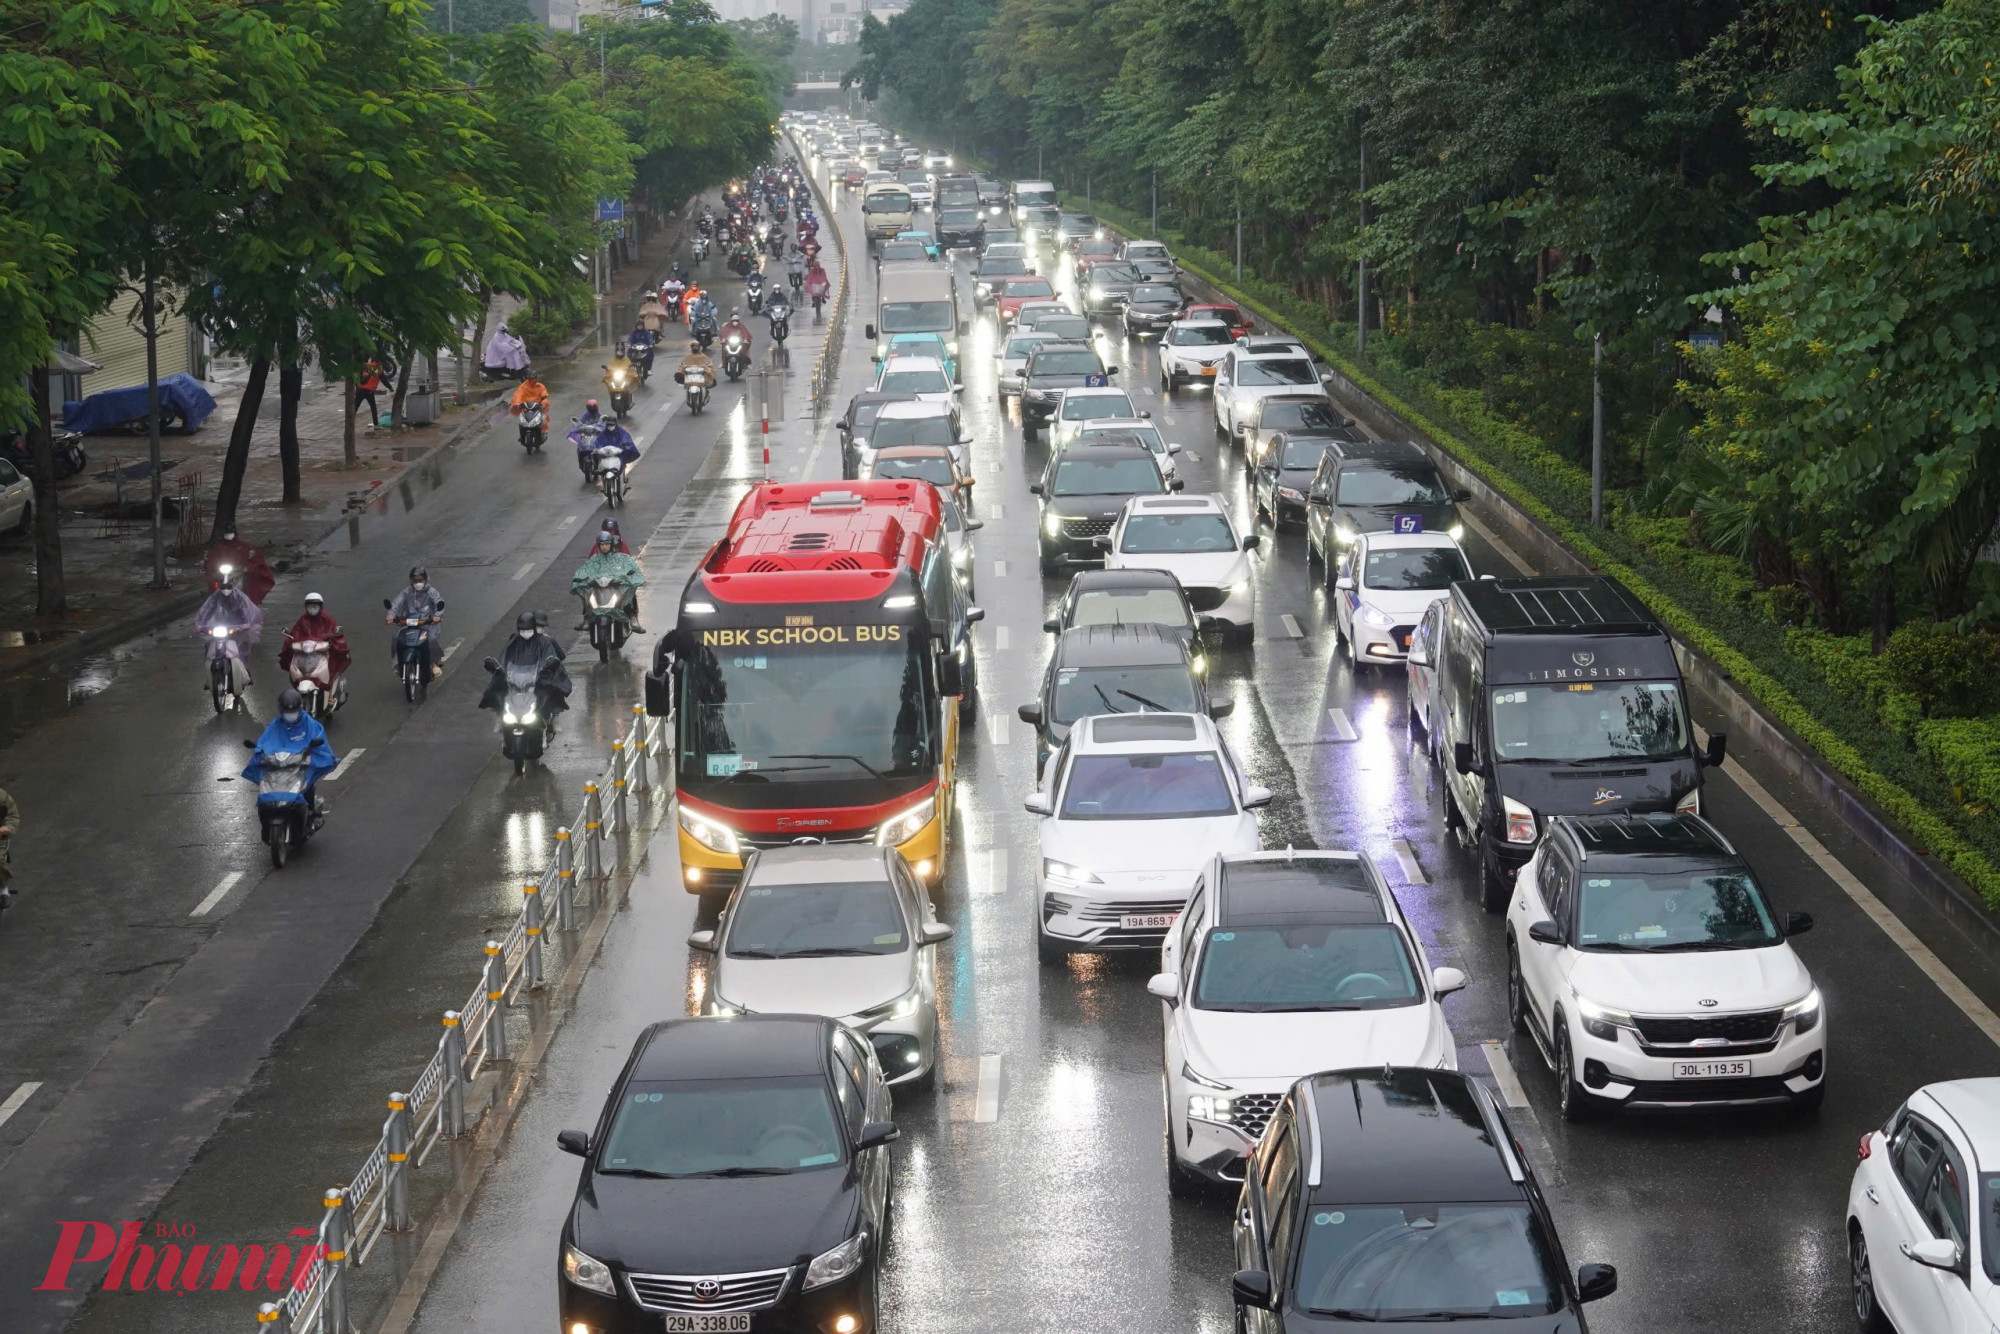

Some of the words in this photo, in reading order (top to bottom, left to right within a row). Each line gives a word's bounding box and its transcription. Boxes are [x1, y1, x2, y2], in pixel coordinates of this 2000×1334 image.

[1401, 517, 1416, 532] G7
[703, 629, 750, 646] NBK
[756, 626, 849, 645] SCHOOL
[856, 624, 901, 642] BUS
[1529, 668, 1642, 680] LIMOSINE
[1126, 916, 1178, 927] 19A-869.7
[1700, 999, 1717, 1007] KIA
[1680, 1063, 1744, 1076] 30L-119.35
[668, 1315, 748, 1332] 29A-338.06
